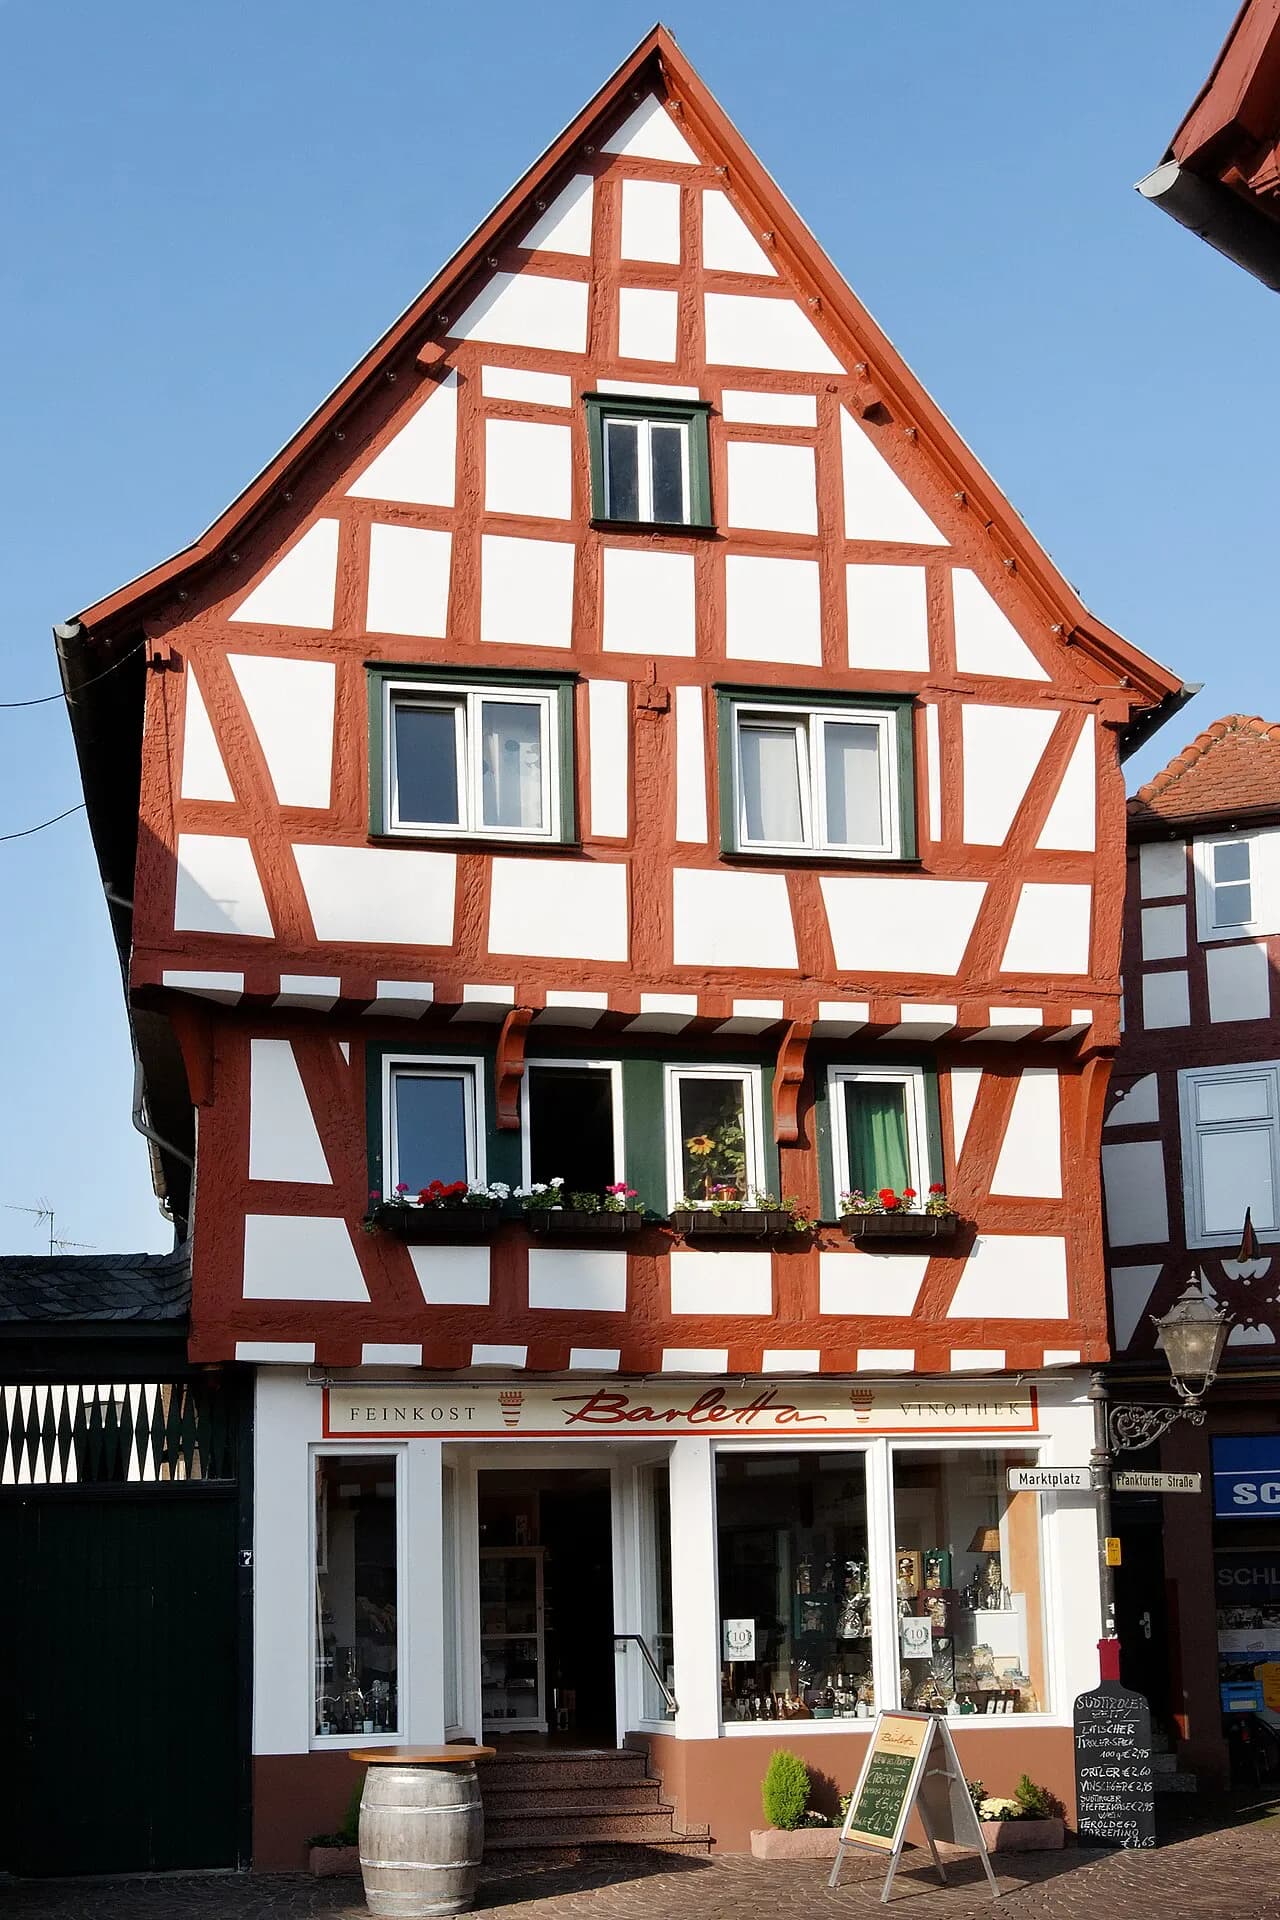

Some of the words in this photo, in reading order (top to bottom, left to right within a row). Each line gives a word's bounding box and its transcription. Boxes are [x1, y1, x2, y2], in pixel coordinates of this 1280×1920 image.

[552, 1387, 827, 1425] Barletta
[900, 1402, 1022, 1416] VINOTHEK
[350, 1407, 476, 1421] FEINKOST
[1018, 1472, 1081, 1487] Marktplatz
[1116, 1473, 1163, 1487] Frankfurter
[1167, 1476, 1194, 1487] Straße
[243, 1551, 252, 1565] 7
[734, 1632, 746, 1641] 10
[912, 1629, 923, 1639] 10
[1080, 1766, 1121, 1778] ORTLER
